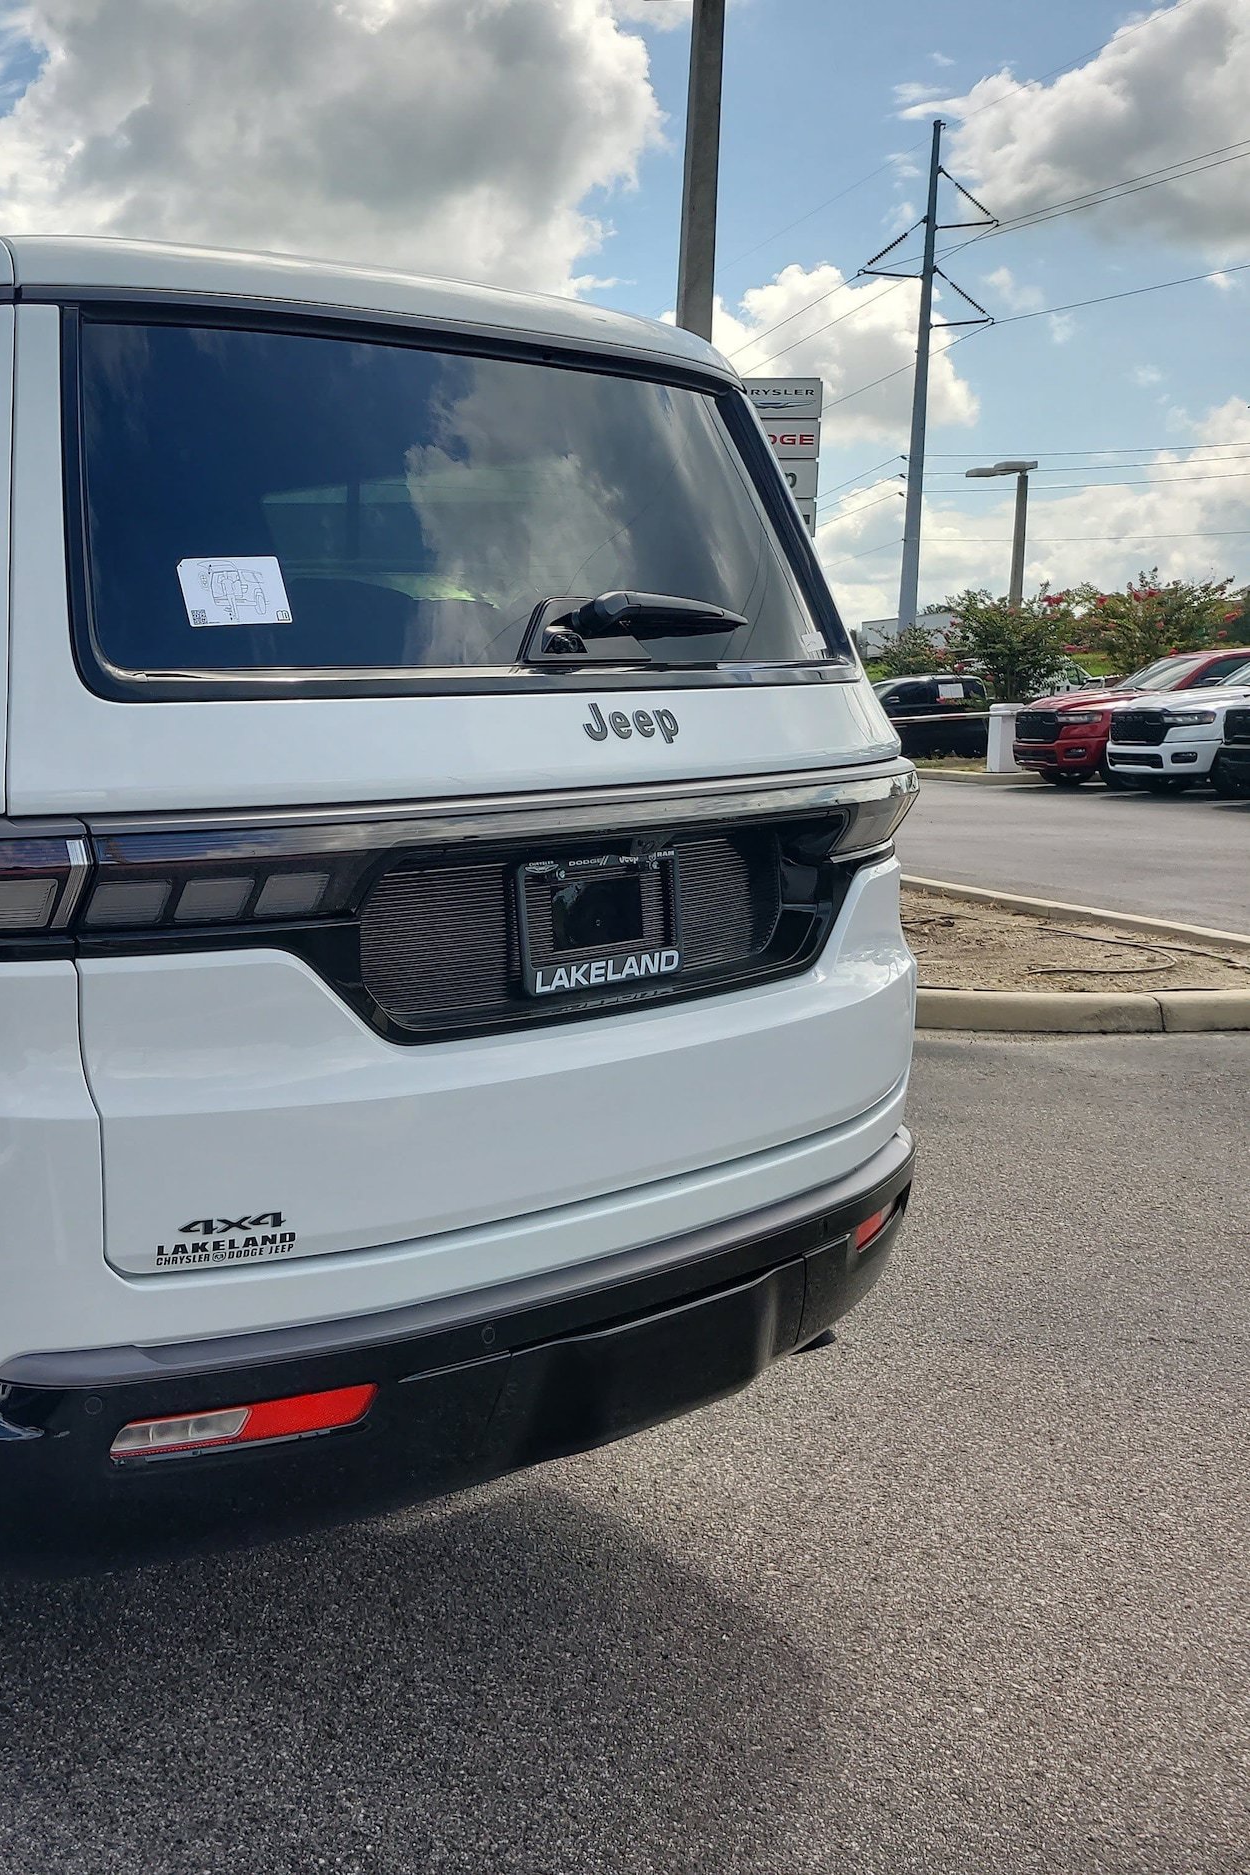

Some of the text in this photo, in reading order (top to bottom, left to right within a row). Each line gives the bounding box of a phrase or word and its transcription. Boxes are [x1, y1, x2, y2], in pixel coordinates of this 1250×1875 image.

[582, 702, 679, 744] Jeep
[536, 950, 679, 993] LAKELAND
[156, 1243, 294, 1266] CHRYSLER DODGE JEEP
[157, 1232, 296, 1256] LAKELAND
